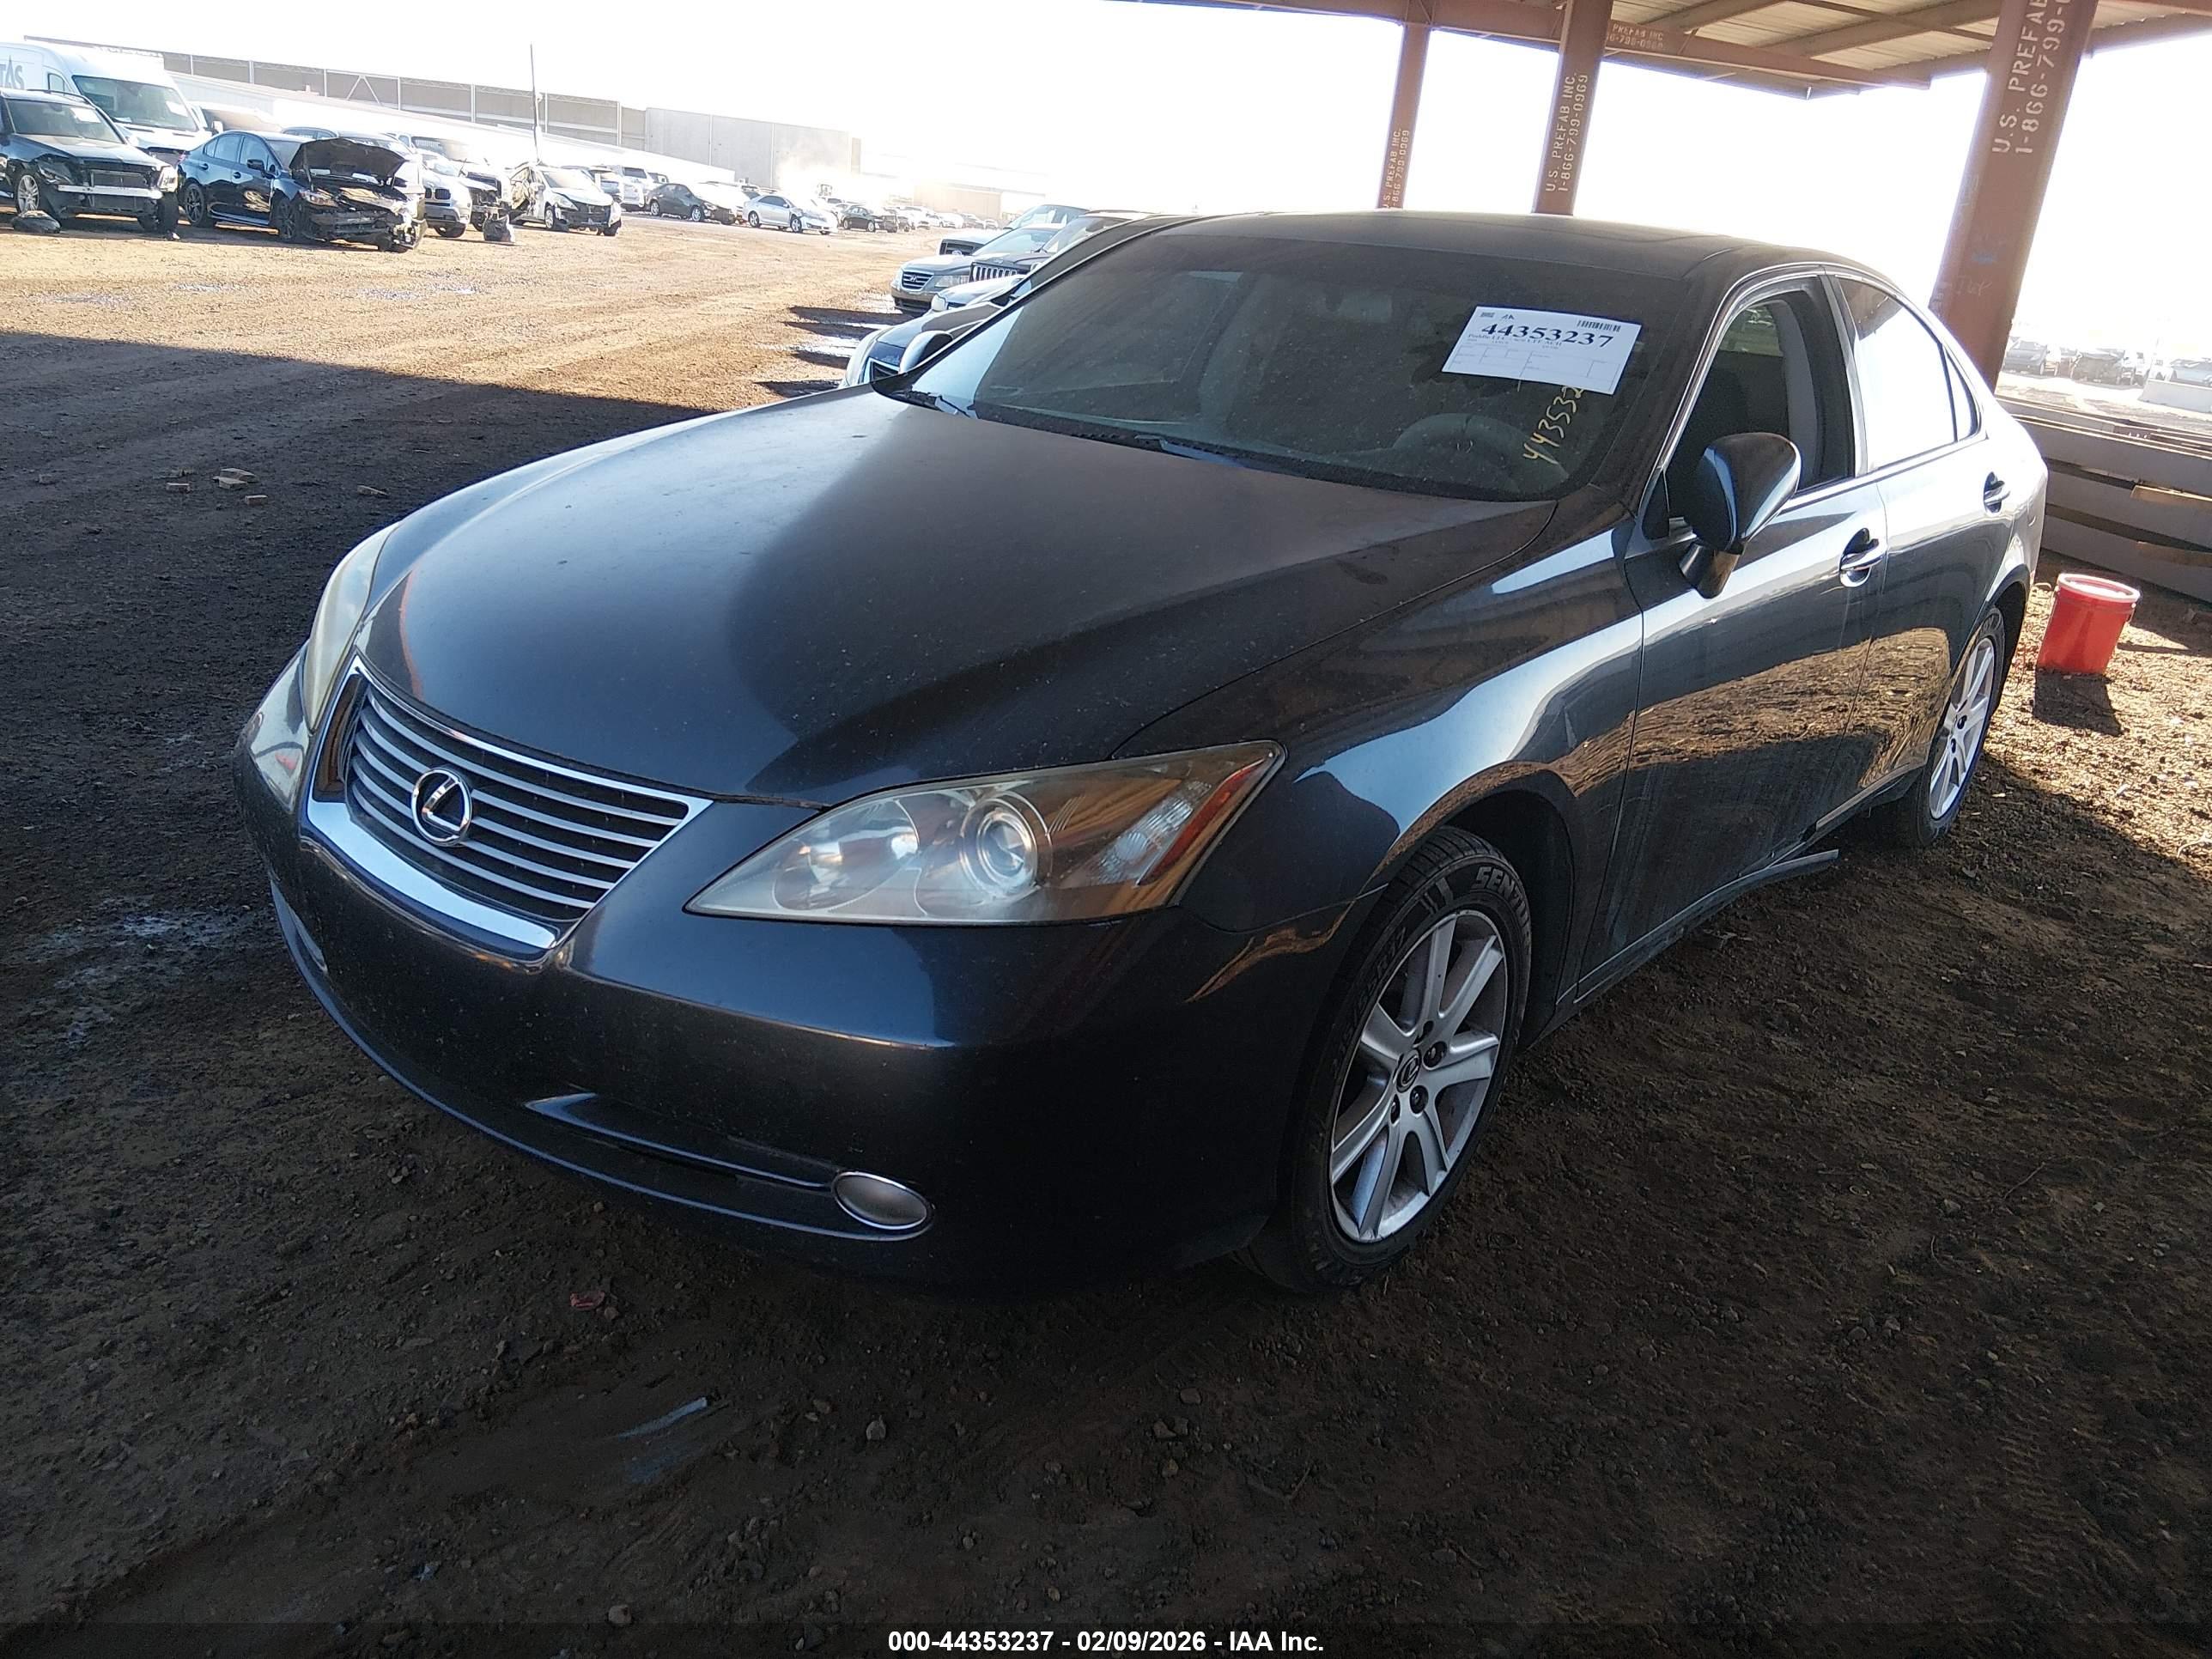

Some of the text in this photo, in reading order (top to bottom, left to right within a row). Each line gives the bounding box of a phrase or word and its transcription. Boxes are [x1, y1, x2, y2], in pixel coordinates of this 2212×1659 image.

[2015, 0, 2071, 153] 1-866-799-
[1385, 151, 1398, 187] PREFAB
[1546, 73, 1577, 191] U.S. PREFAB INC.
[1558, 75, 1589, 191] 1-866-799-0969
[1992, 108, 2020, 153] U.S.
[1481, 323, 1613, 348] 44353237
